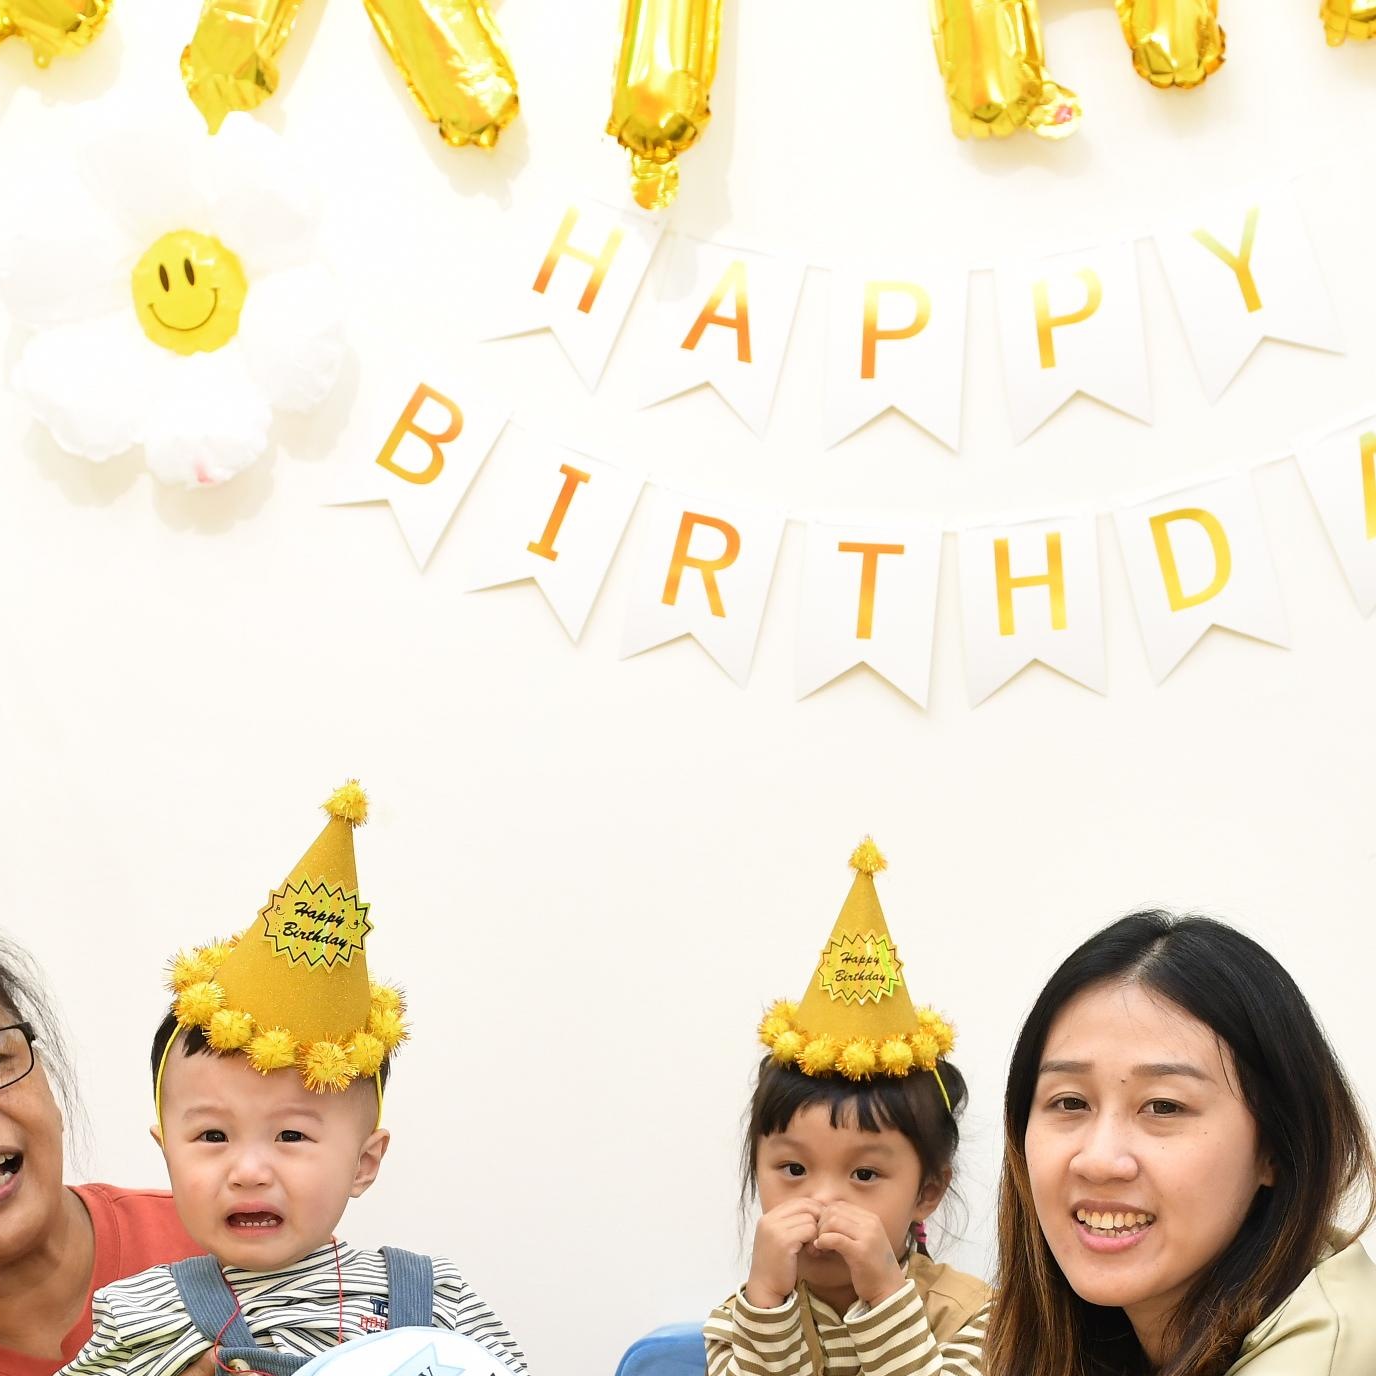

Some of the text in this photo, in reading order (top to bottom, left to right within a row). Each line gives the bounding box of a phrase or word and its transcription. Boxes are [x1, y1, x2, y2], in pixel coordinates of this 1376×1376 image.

[532, 203, 1265, 380] HAPPY
[294, 902, 345, 928] Happy
[282, 921, 348, 951] Birthday
[840, 952, 880, 967] Happy
[835, 969, 886, 984] Birthday
